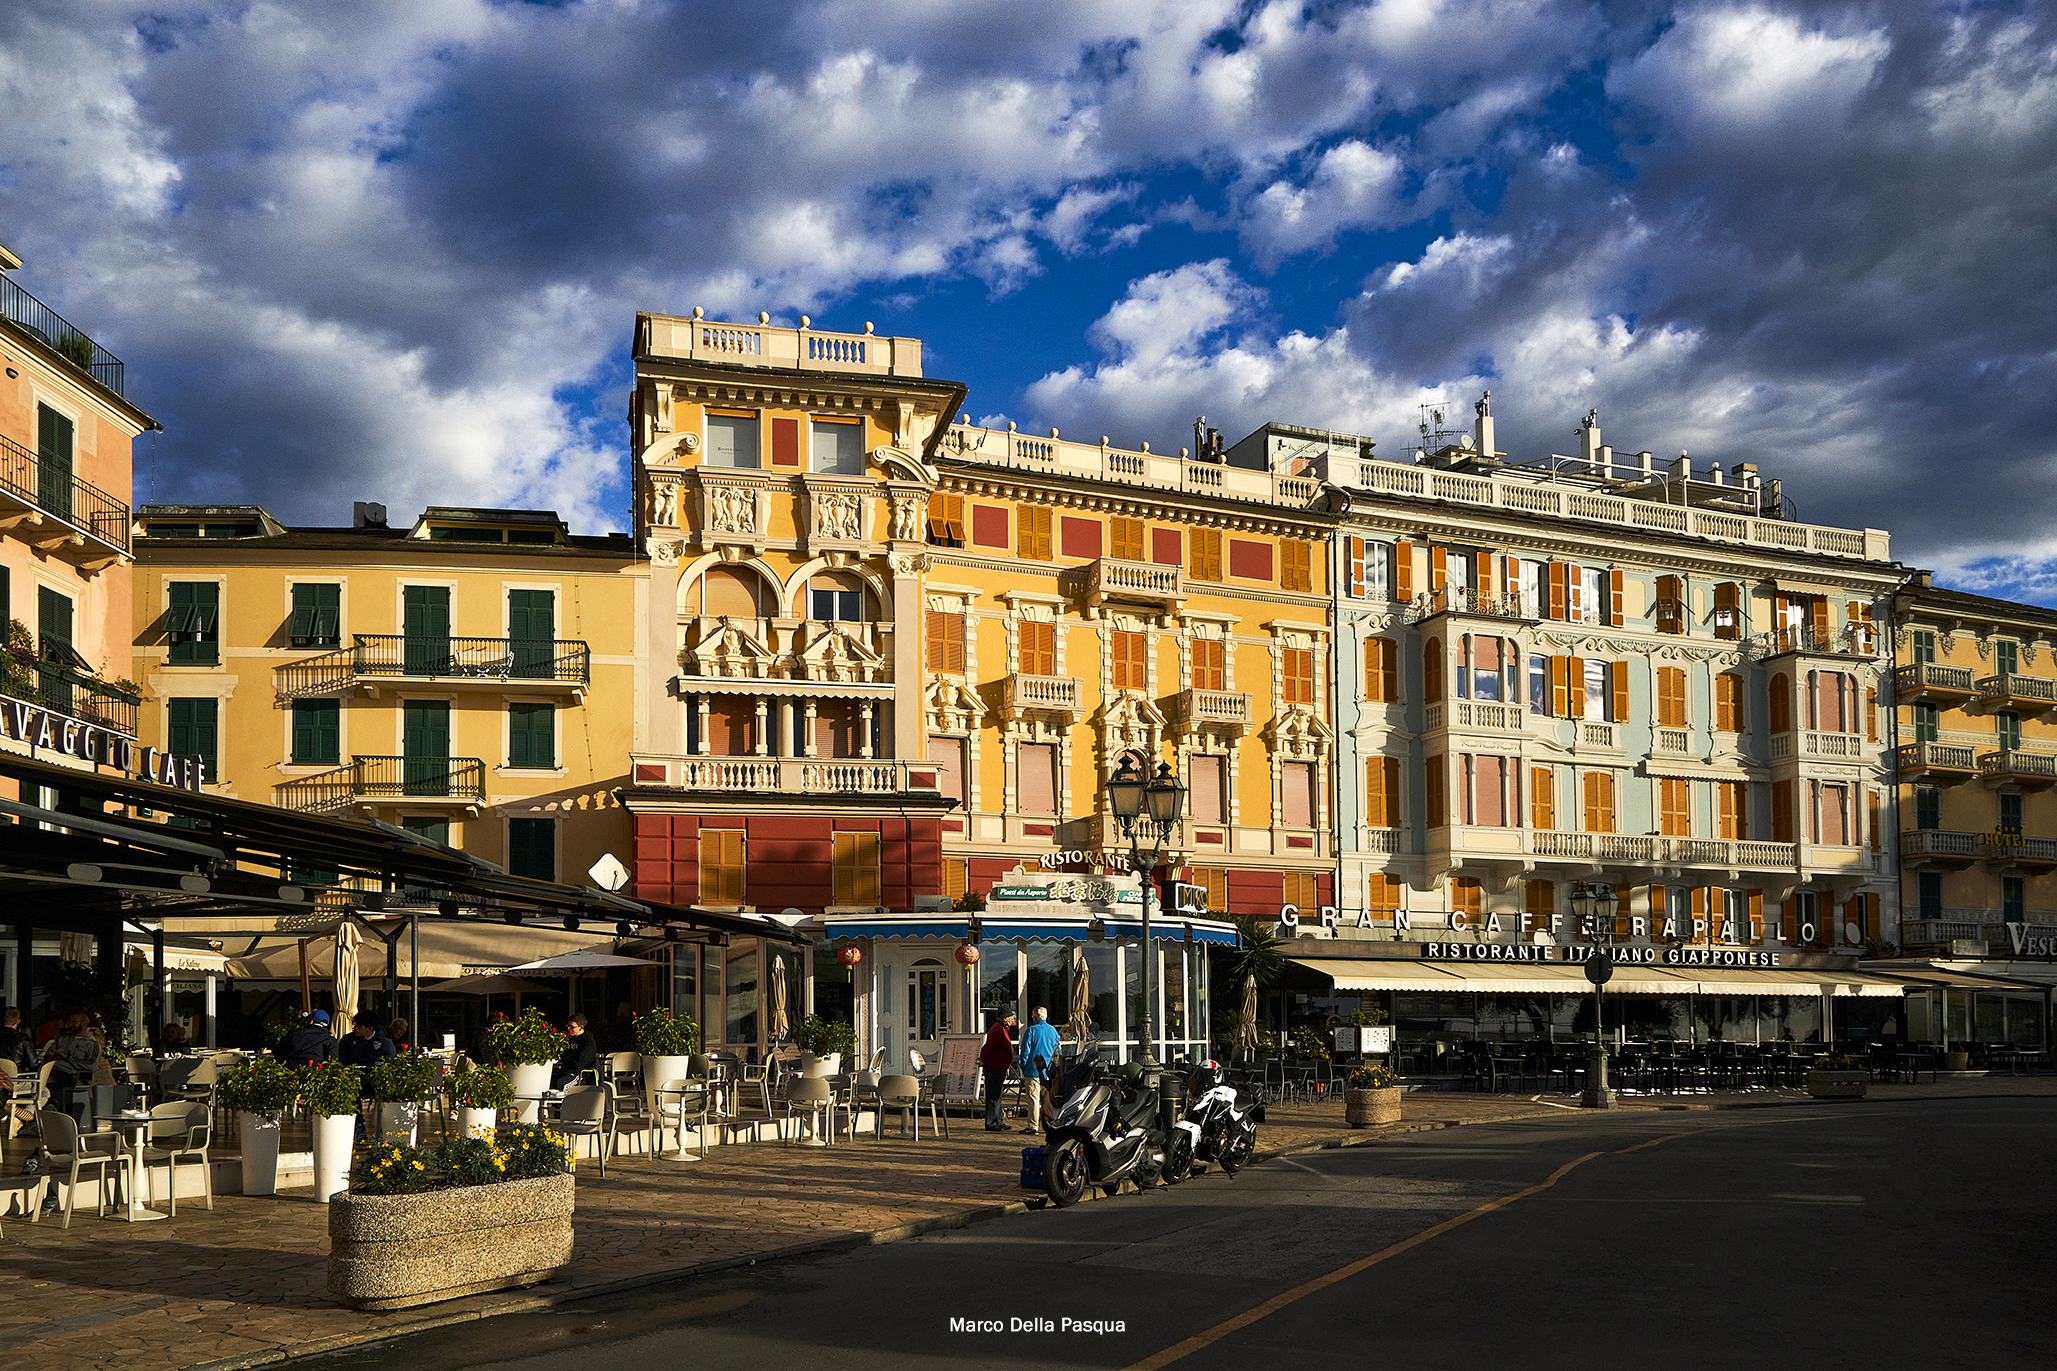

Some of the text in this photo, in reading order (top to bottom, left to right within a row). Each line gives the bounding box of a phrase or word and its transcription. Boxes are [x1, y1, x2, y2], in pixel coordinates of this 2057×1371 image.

[1984, 833, 2029, 847] HOTEL
[1040, 850, 1131, 872] RISTORANTE
[1281, 903, 1411, 931] GRAN
[1633, 916, 1815, 942] RAPALLO
[1428, 943, 1553, 960] RISTORANTE
[1669, 949, 1780, 966] GIAPPONESE
